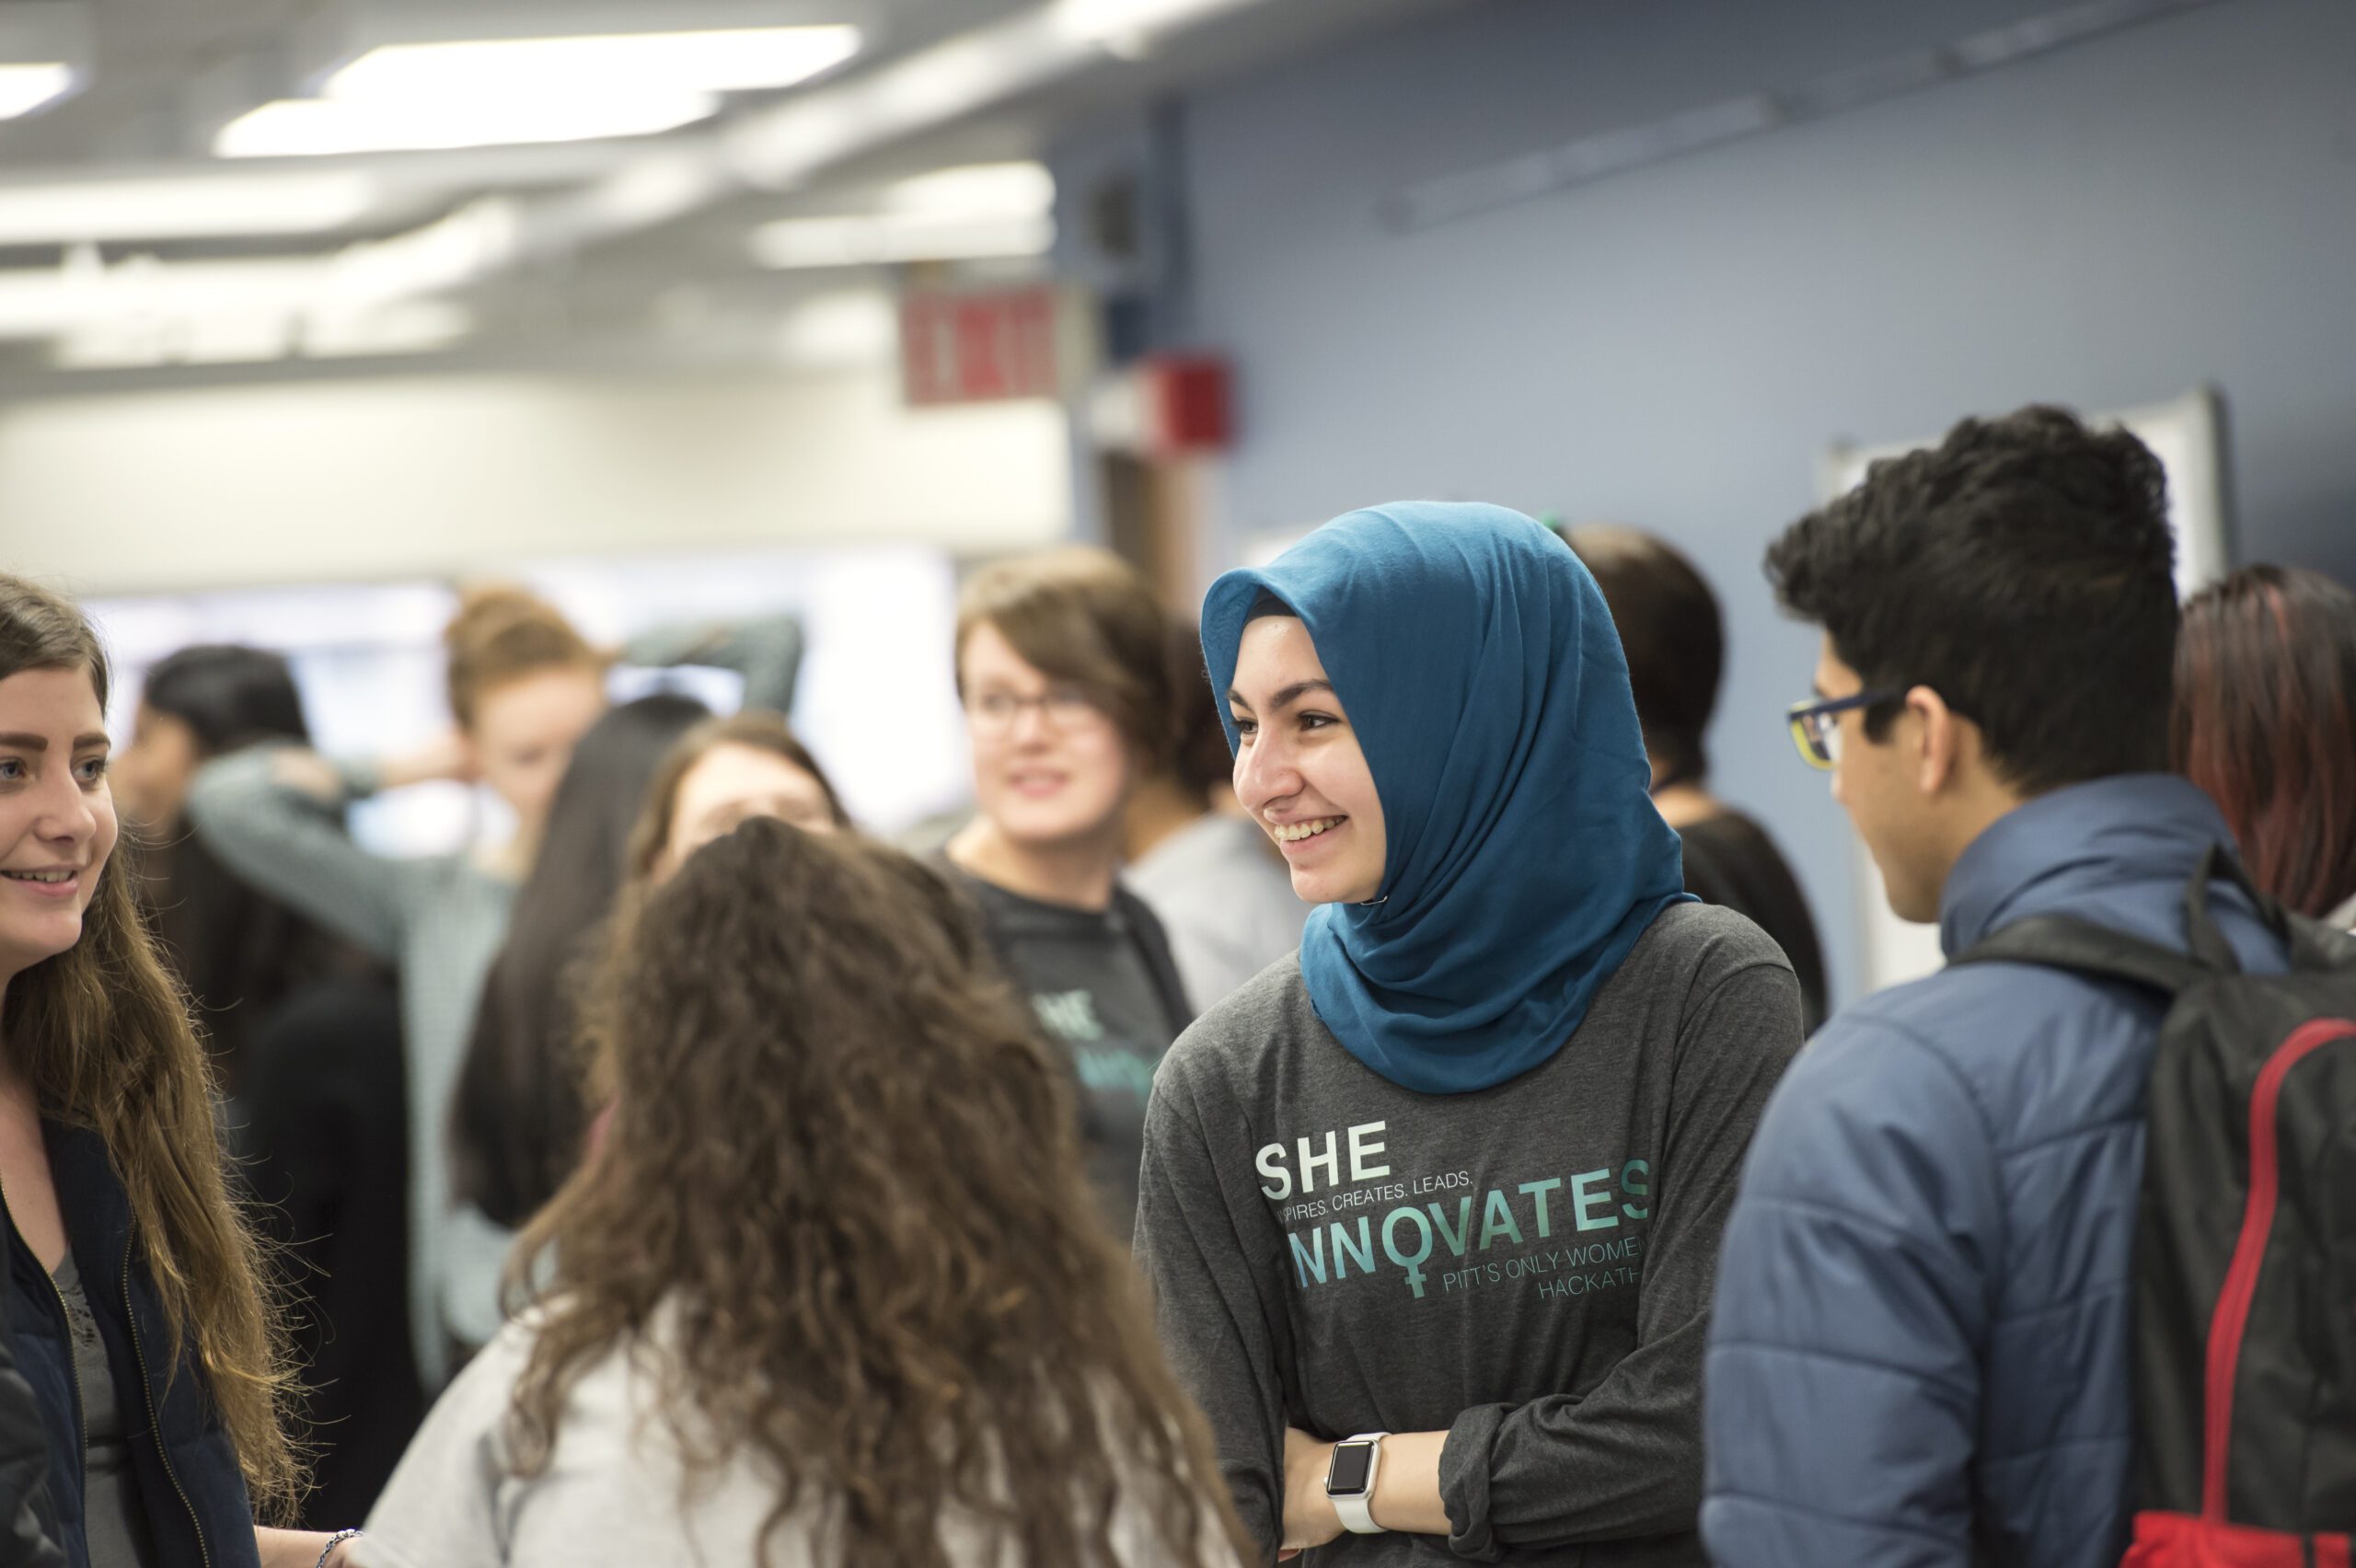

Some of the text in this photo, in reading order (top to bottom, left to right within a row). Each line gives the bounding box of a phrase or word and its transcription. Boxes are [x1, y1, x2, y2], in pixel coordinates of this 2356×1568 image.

[1255, 1120, 1390, 1201] SHE
[1276, 1170, 1472, 1224] PIRES. CREATES. LEADS.
[1443, 1262, 1501, 1292] PITT'S
[1506, 1251, 1559, 1279] ONLY
